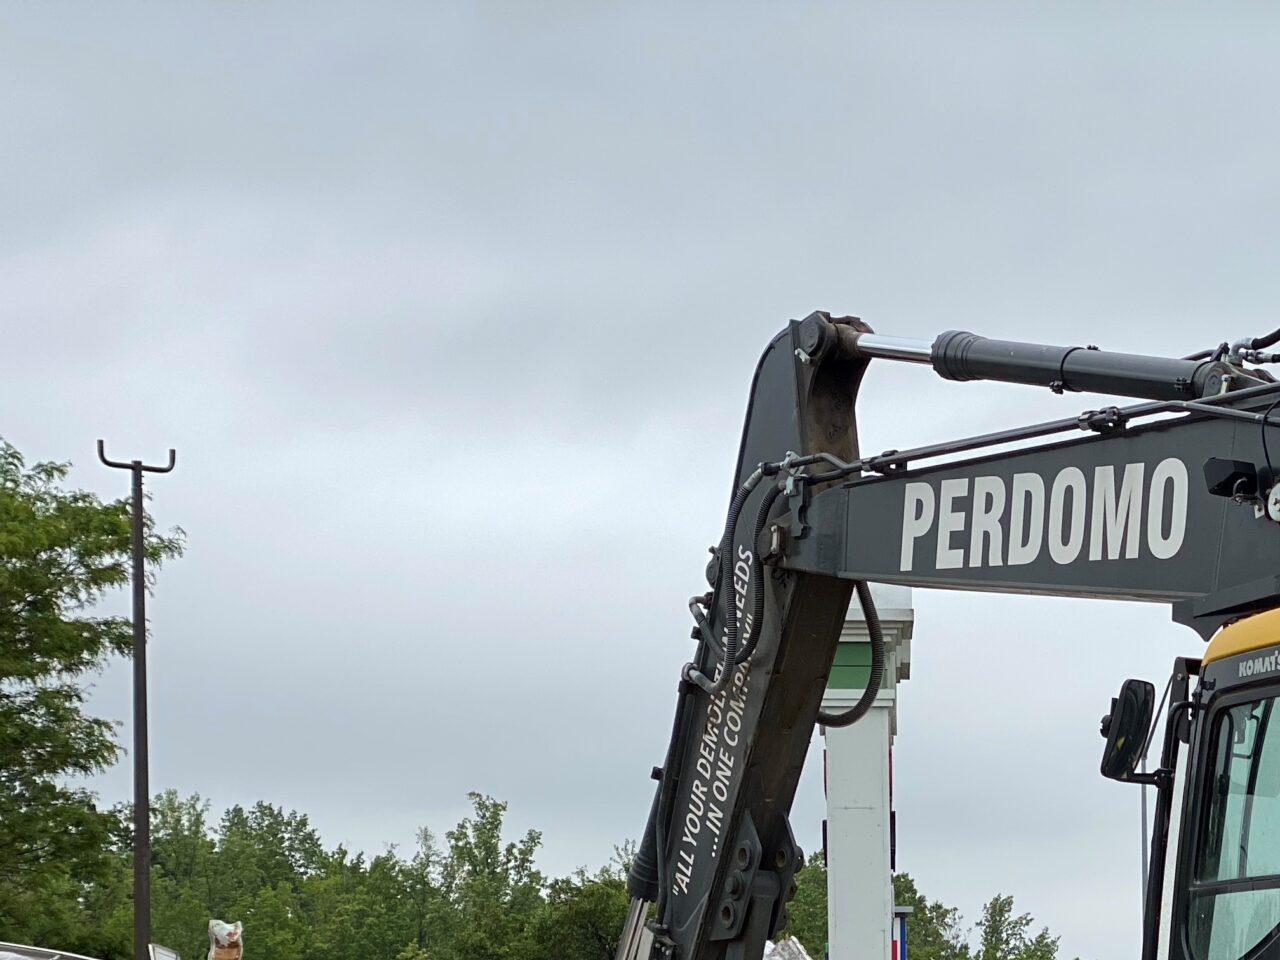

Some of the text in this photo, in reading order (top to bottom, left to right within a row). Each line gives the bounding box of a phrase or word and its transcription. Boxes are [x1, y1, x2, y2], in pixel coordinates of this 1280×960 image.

[900, 457, 1189, 571] PERDOMO
[696, 626, 730, 780] DEMOLT
[723, 613, 756, 748] COMPAY"
[682, 779, 708, 847] YOUR
[713, 748, 735, 802] ONE
[672, 850, 695, 896] "ALL
